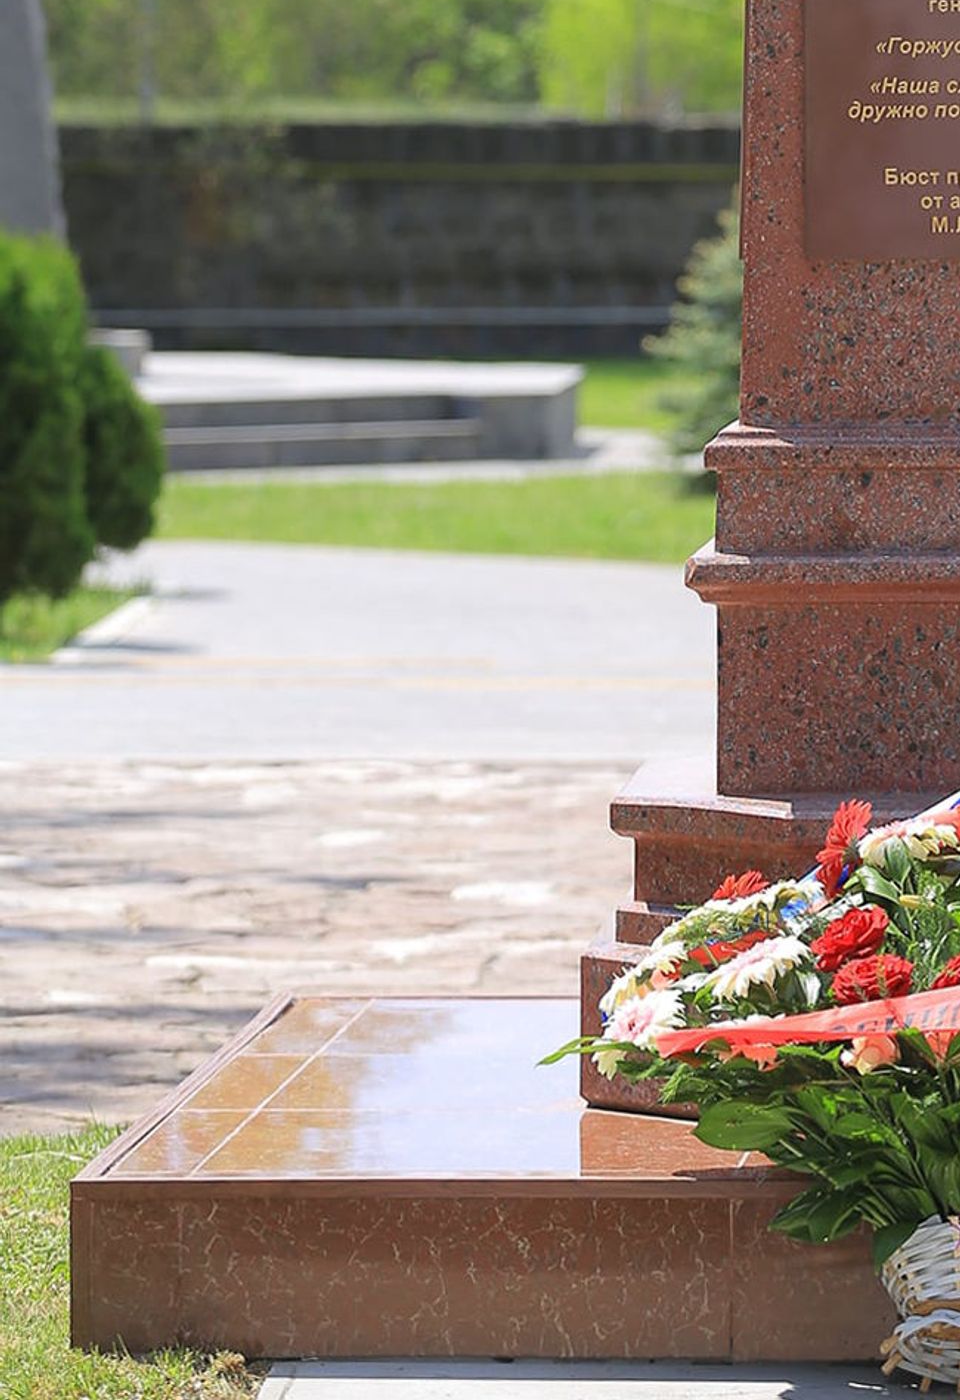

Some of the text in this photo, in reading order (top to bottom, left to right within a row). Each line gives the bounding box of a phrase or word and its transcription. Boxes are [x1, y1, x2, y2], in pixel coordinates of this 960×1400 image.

[871, 77, 939, 95] «Наша
[849, 101, 928, 123] дружно
[885, 168, 939, 185] Бюст
[921, 196, 943, 210] от
